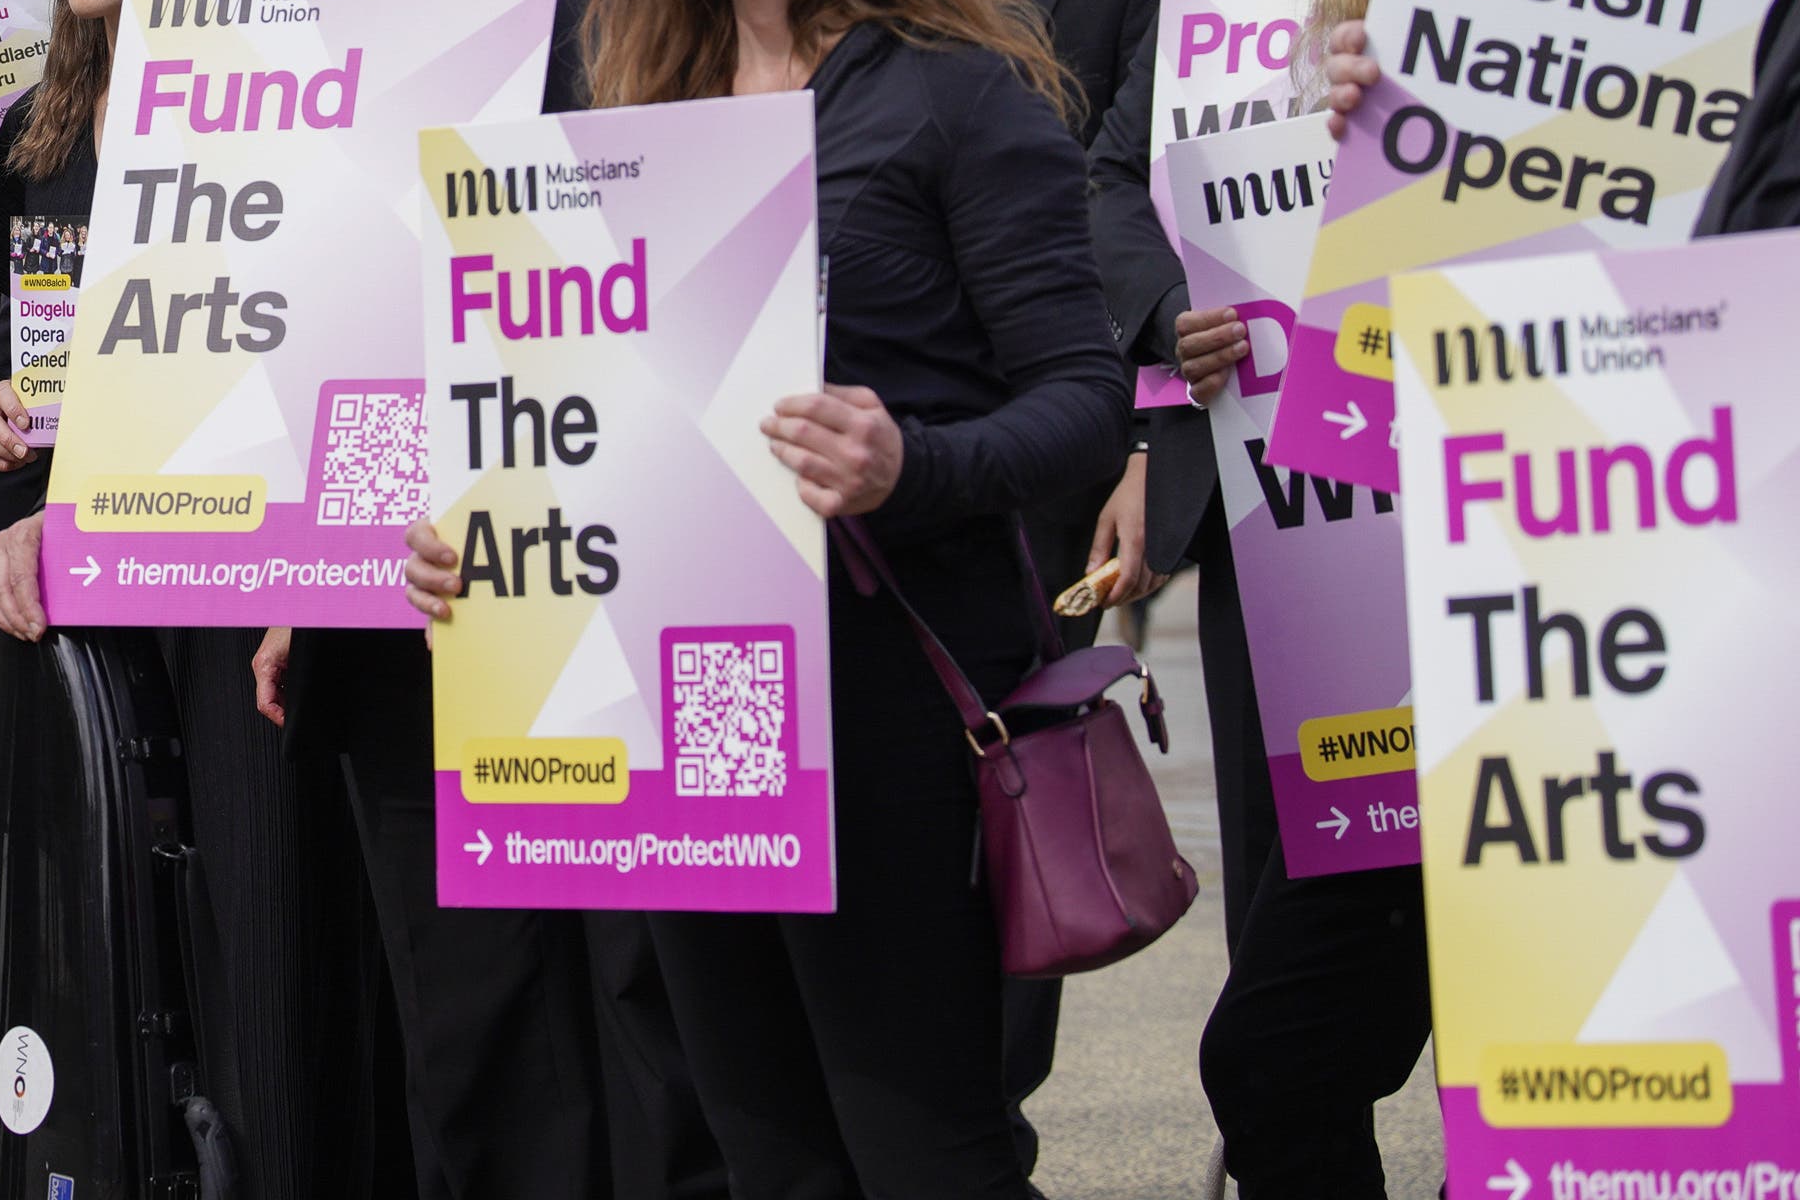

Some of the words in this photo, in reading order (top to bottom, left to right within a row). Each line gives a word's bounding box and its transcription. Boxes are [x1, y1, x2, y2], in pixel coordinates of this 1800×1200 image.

[260, 3, 320, 23] Union
[135, 48, 363, 136] Fund
[1401, 7, 1750, 144] Nationa
[546, 157, 645, 184] Musicians’
[1382, 104, 1657, 226] Opera
[123, 164, 283, 245] The
[546, 185, 602, 210] Union
[20, 300, 75, 321] Diogelu
[24, 279, 67, 288] #WNOBalch
[450, 238, 650, 343] Fund
[20, 326, 65, 346] Opera
[98, 278, 288, 356] Arts
[1580, 341, 1667, 374] Union
[450, 376, 598, 470] The
[91, 492, 252, 517] #WNOProud
[1442, 404, 1740, 545] Fund
[457, 508, 620, 599] Arts
[1447, 584, 1668, 705] The
[474, 756, 616, 785] #WNOProud
[1461, 749, 1707, 869] Arts
[505, 832, 801, 873] themu.org/ProtectWNO
[15, 1034, 30, 1098] WNO
[1498, 1064, 1712, 1102] #WNOProud
